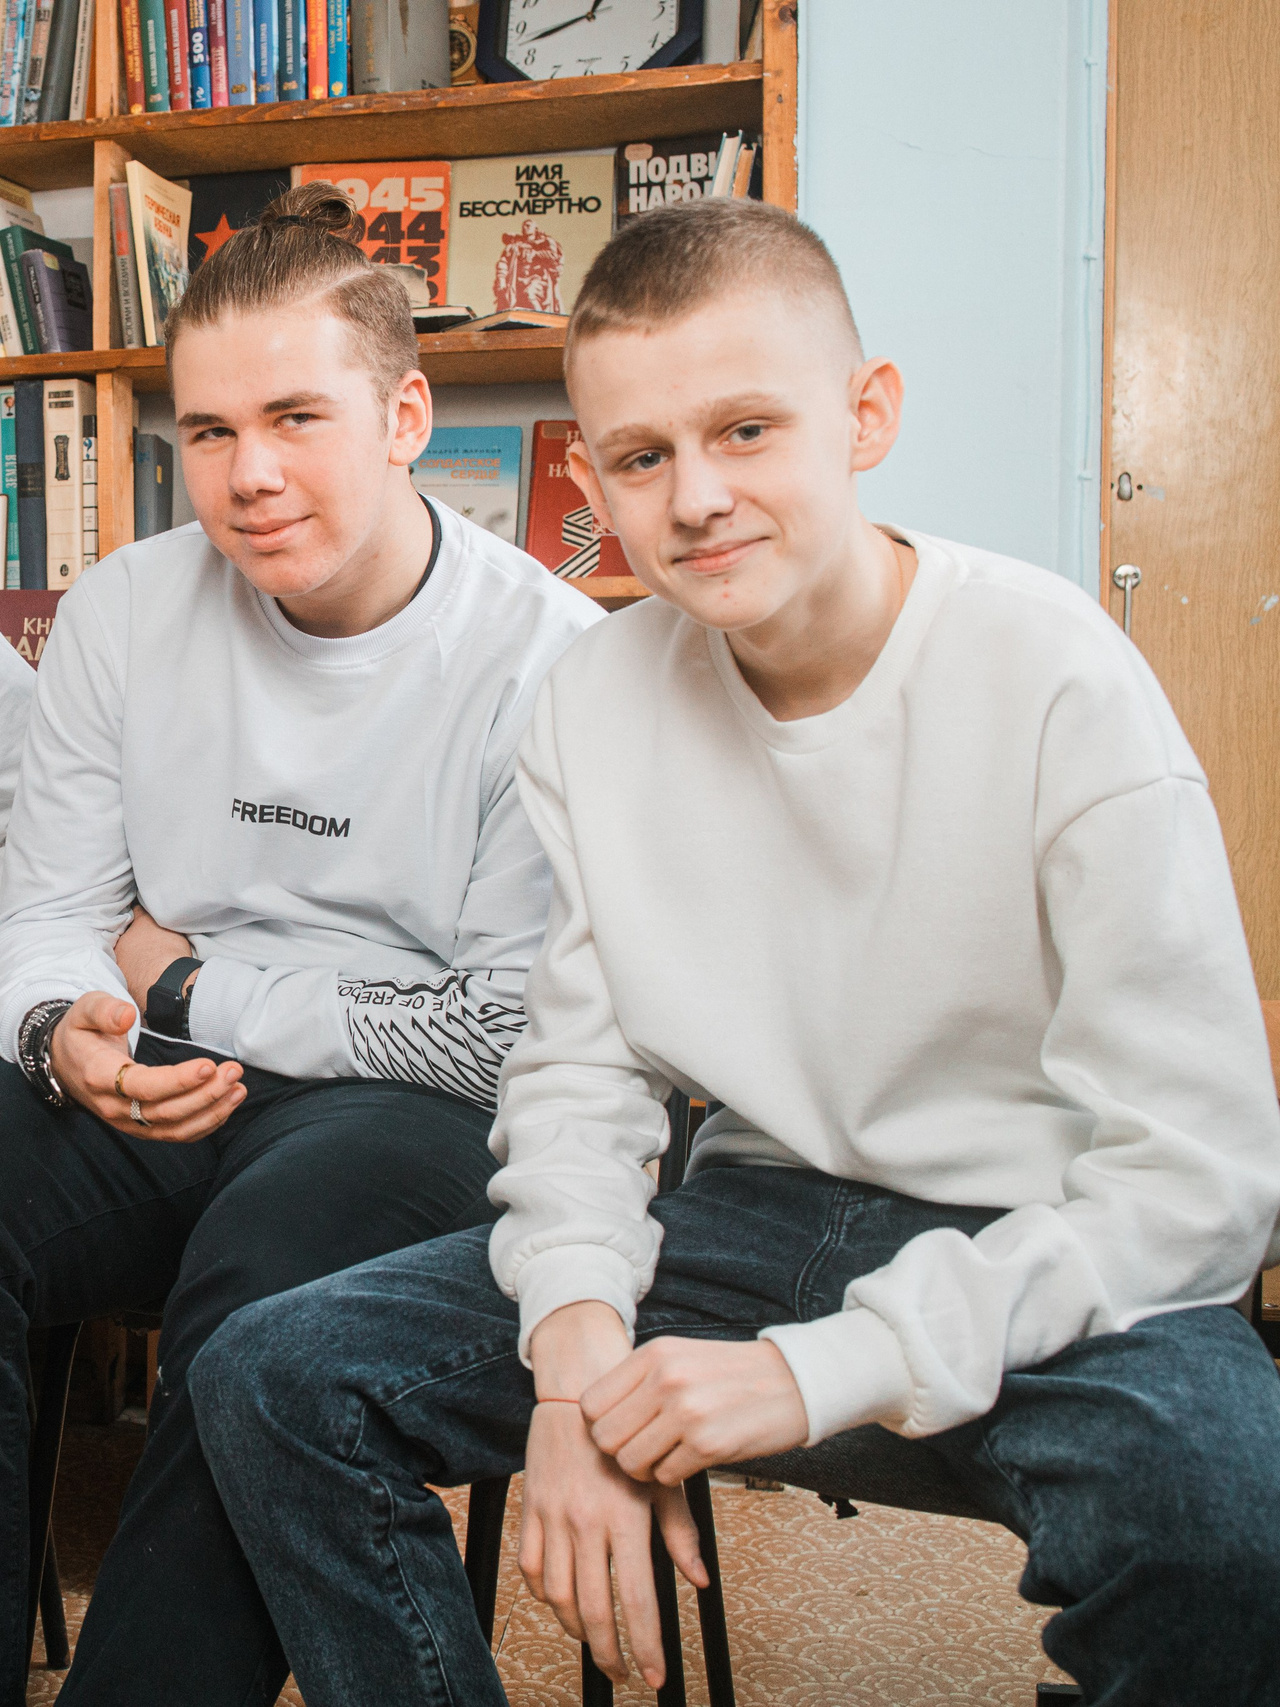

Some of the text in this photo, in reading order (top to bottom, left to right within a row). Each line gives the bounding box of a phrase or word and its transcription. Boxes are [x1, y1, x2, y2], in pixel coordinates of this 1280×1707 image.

[192, 32, 204, 63] 500
[524, 48, 536, 66] 8
[620, 56, 630, 74] 5
[550, 64, 562, 78] 7
[515, 164, 563, 181] ИМЯ
[328, 177, 446, 211] 945
[515, 180, 570, 199] ТВОЕ
[459, 196, 602, 218] БЕССМЕРТНО
[5, 454, 17, 488] ЗЕМЛЯ
[418, 458, 501, 469] СОЛДАТСКОЕ
[450, 469, 500, 480] СЕРДЦЕ
[231, 798, 351, 837] FREEDOM
[398, 995, 425, 1010] OF
